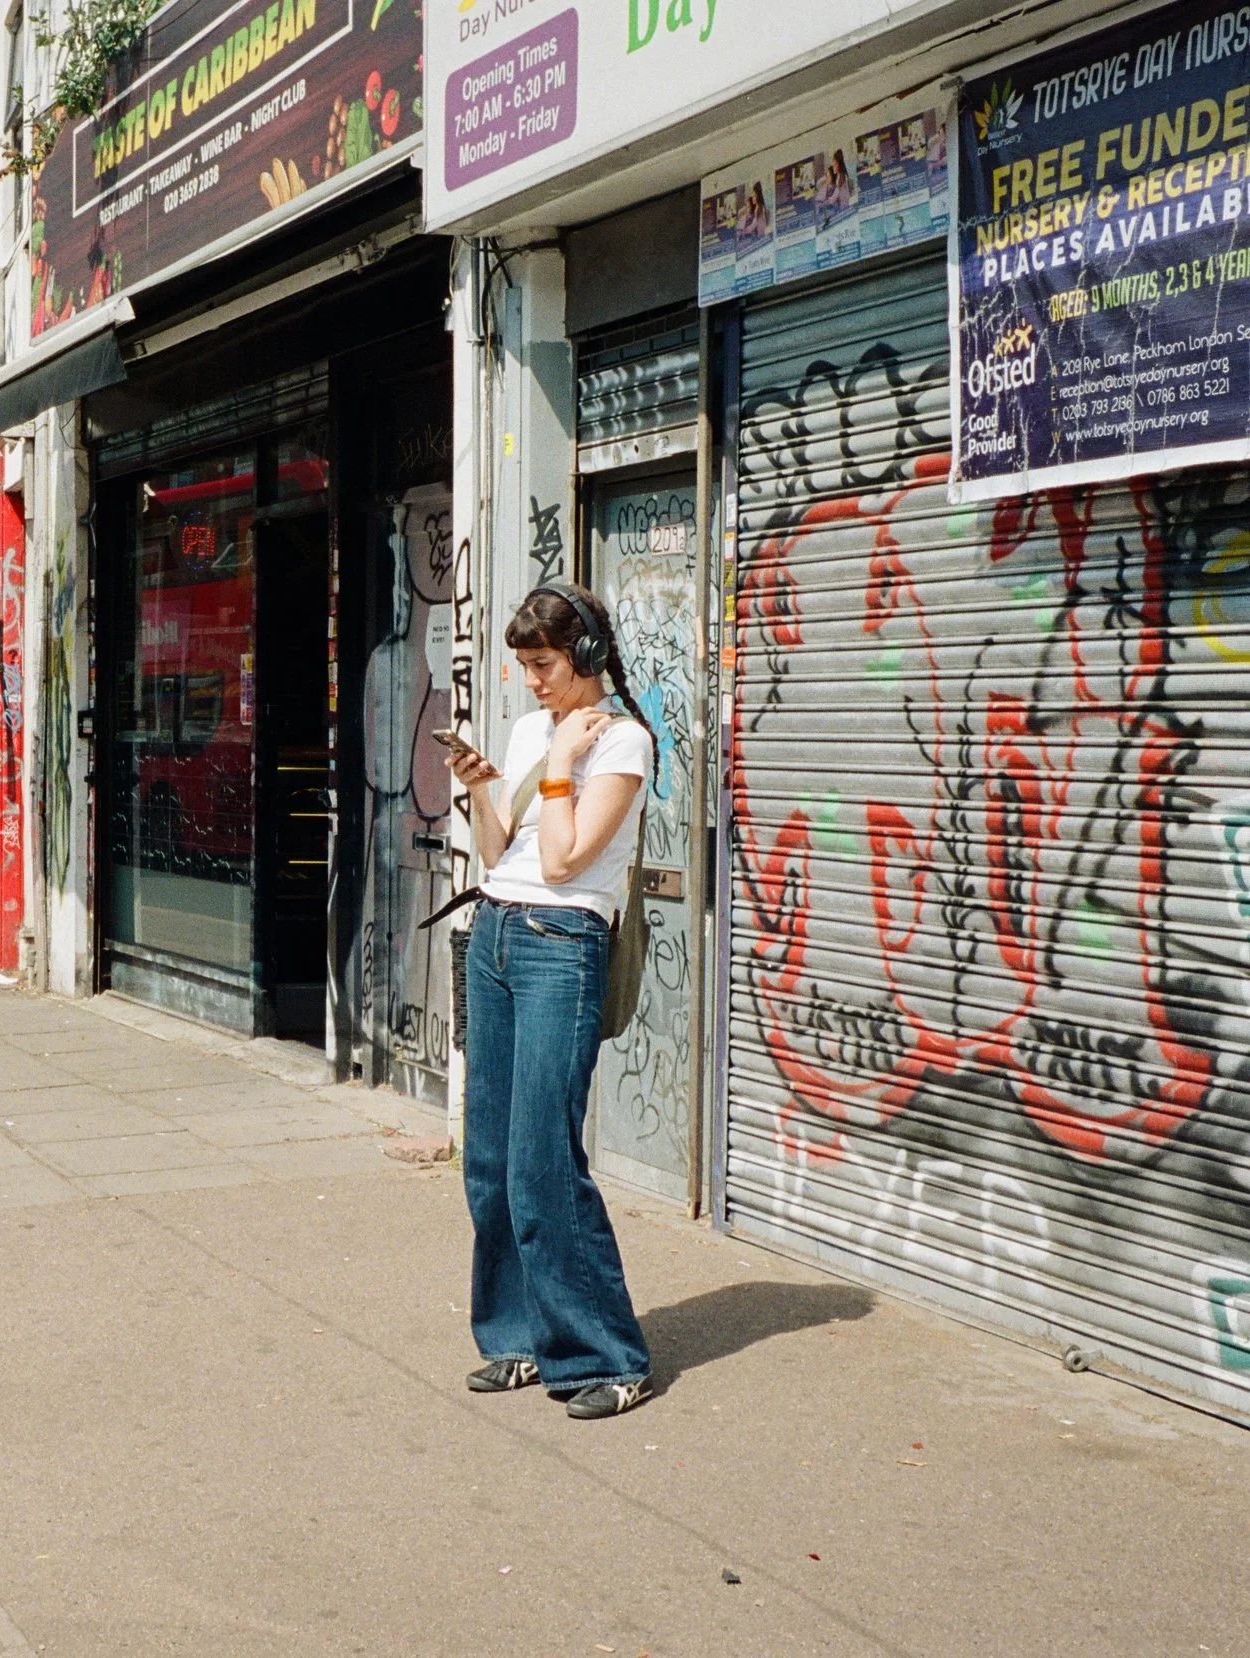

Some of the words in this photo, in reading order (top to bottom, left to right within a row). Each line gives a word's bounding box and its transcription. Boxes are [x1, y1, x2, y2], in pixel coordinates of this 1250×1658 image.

[459, 10, 490, 42] Day
[626, 0, 716, 55] Day
[93, 101, 146, 179] TASTE
[150, 78, 178, 139] OF
[181, 0, 316, 117] CARIBBEAN
[462, 60, 515, 102] Opening
[517, 37, 558, 72] Times
[1033, 51, 1129, 123] TOTSRYE
[1134, 31, 1181, 88] DAY
[1185, 6, 1250, 71] NURS
[454, 105, 479, 137] 7:00
[481, 93, 503, 125] AM
[513, 74, 541, 109] 6:30
[544, 61, 566, 93] PM
[99, 184, 145, 226] RESTAURANT
[149, 153, 193, 195] TAKEAWAY
[200, 133, 225, 164] WINE
[223, 121, 242, 150] BAR
[250, 97, 281, 132] NIGHT
[280, 78, 306, 112] CLUB
[459, 130, 507, 168] Monday
[517, 105, 560, 140] Friday
[163, 192, 179, 213] 020
[992, 139, 1086, 214] FREE
[976, 190, 1091, 256] NURSERY
[1096, 184, 1121, 219] &
[983, 230, 1084, 287] PLACES
[1095, 184, 1250, 254] AVAILAB
[1050, 288, 1089, 322] AGED:
[1091, 285, 1100, 313] 9
[1101, 270, 1162, 310] MONTHS,
[1192, 260, 1203, 288] &
[1205, 256, 1215, 285] 4
[968, 343, 1036, 398] Ofsted
[1062, 359, 1082, 377] 209
[1083, 356, 1101, 374] Rye
[1133, 341, 1186, 360] Peckham
[1188, 331, 1232, 351] London
[969, 408, 998, 433] Good
[1050, 385, 1056, 401] E
[1062, 402, 1088, 420] 0203
[1091, 398, 1108, 416] 793
[1110, 394, 1133, 413] 2136
[1147, 386, 1176, 406] 0786
[1179, 382, 1200, 401] 863
[1204, 377, 1230, 396] 5221
[968, 431, 1017, 456] Provider
